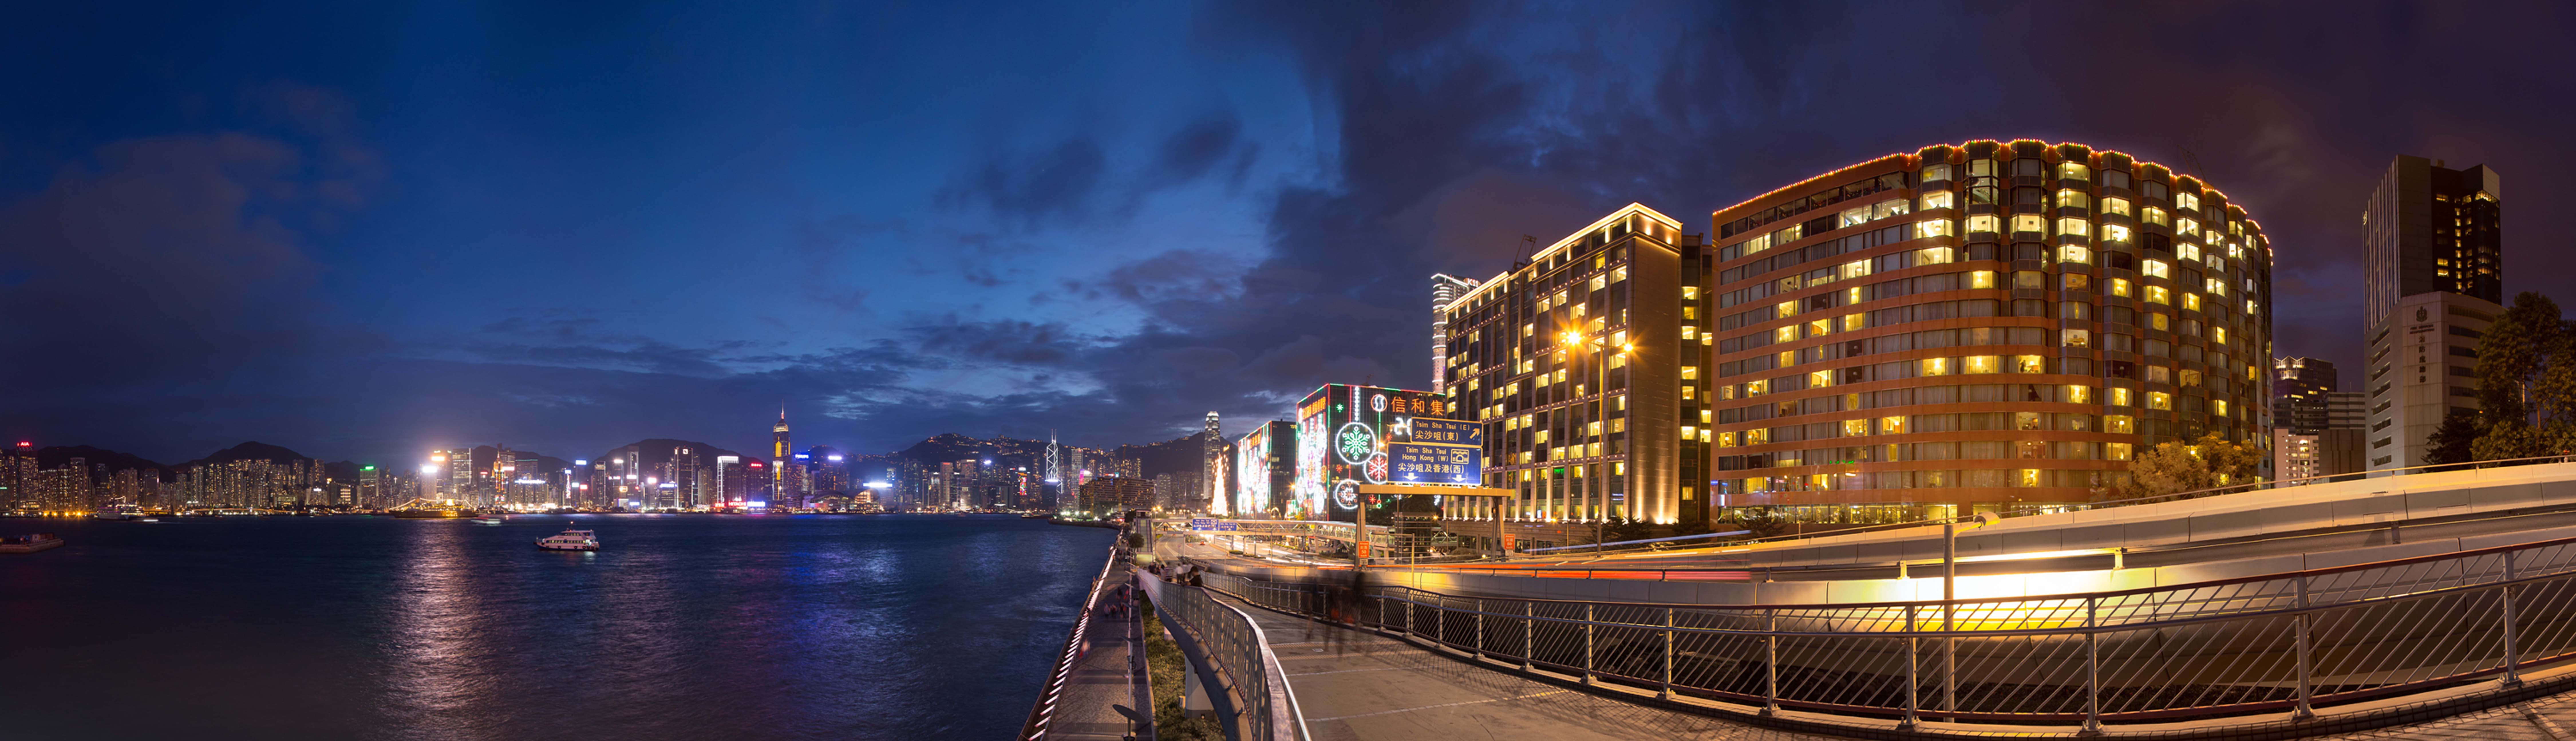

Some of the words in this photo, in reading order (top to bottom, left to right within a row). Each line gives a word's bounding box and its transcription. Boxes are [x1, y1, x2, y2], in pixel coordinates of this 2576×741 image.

[1468, 278, 1478, 287] K11
[1391, 396, 1445, 416] 信和集
[1415, 430, 1459, 441] 尖沙咀(東)
[1398, 463, 1464, 474] 尖沙咀及香港(西)
